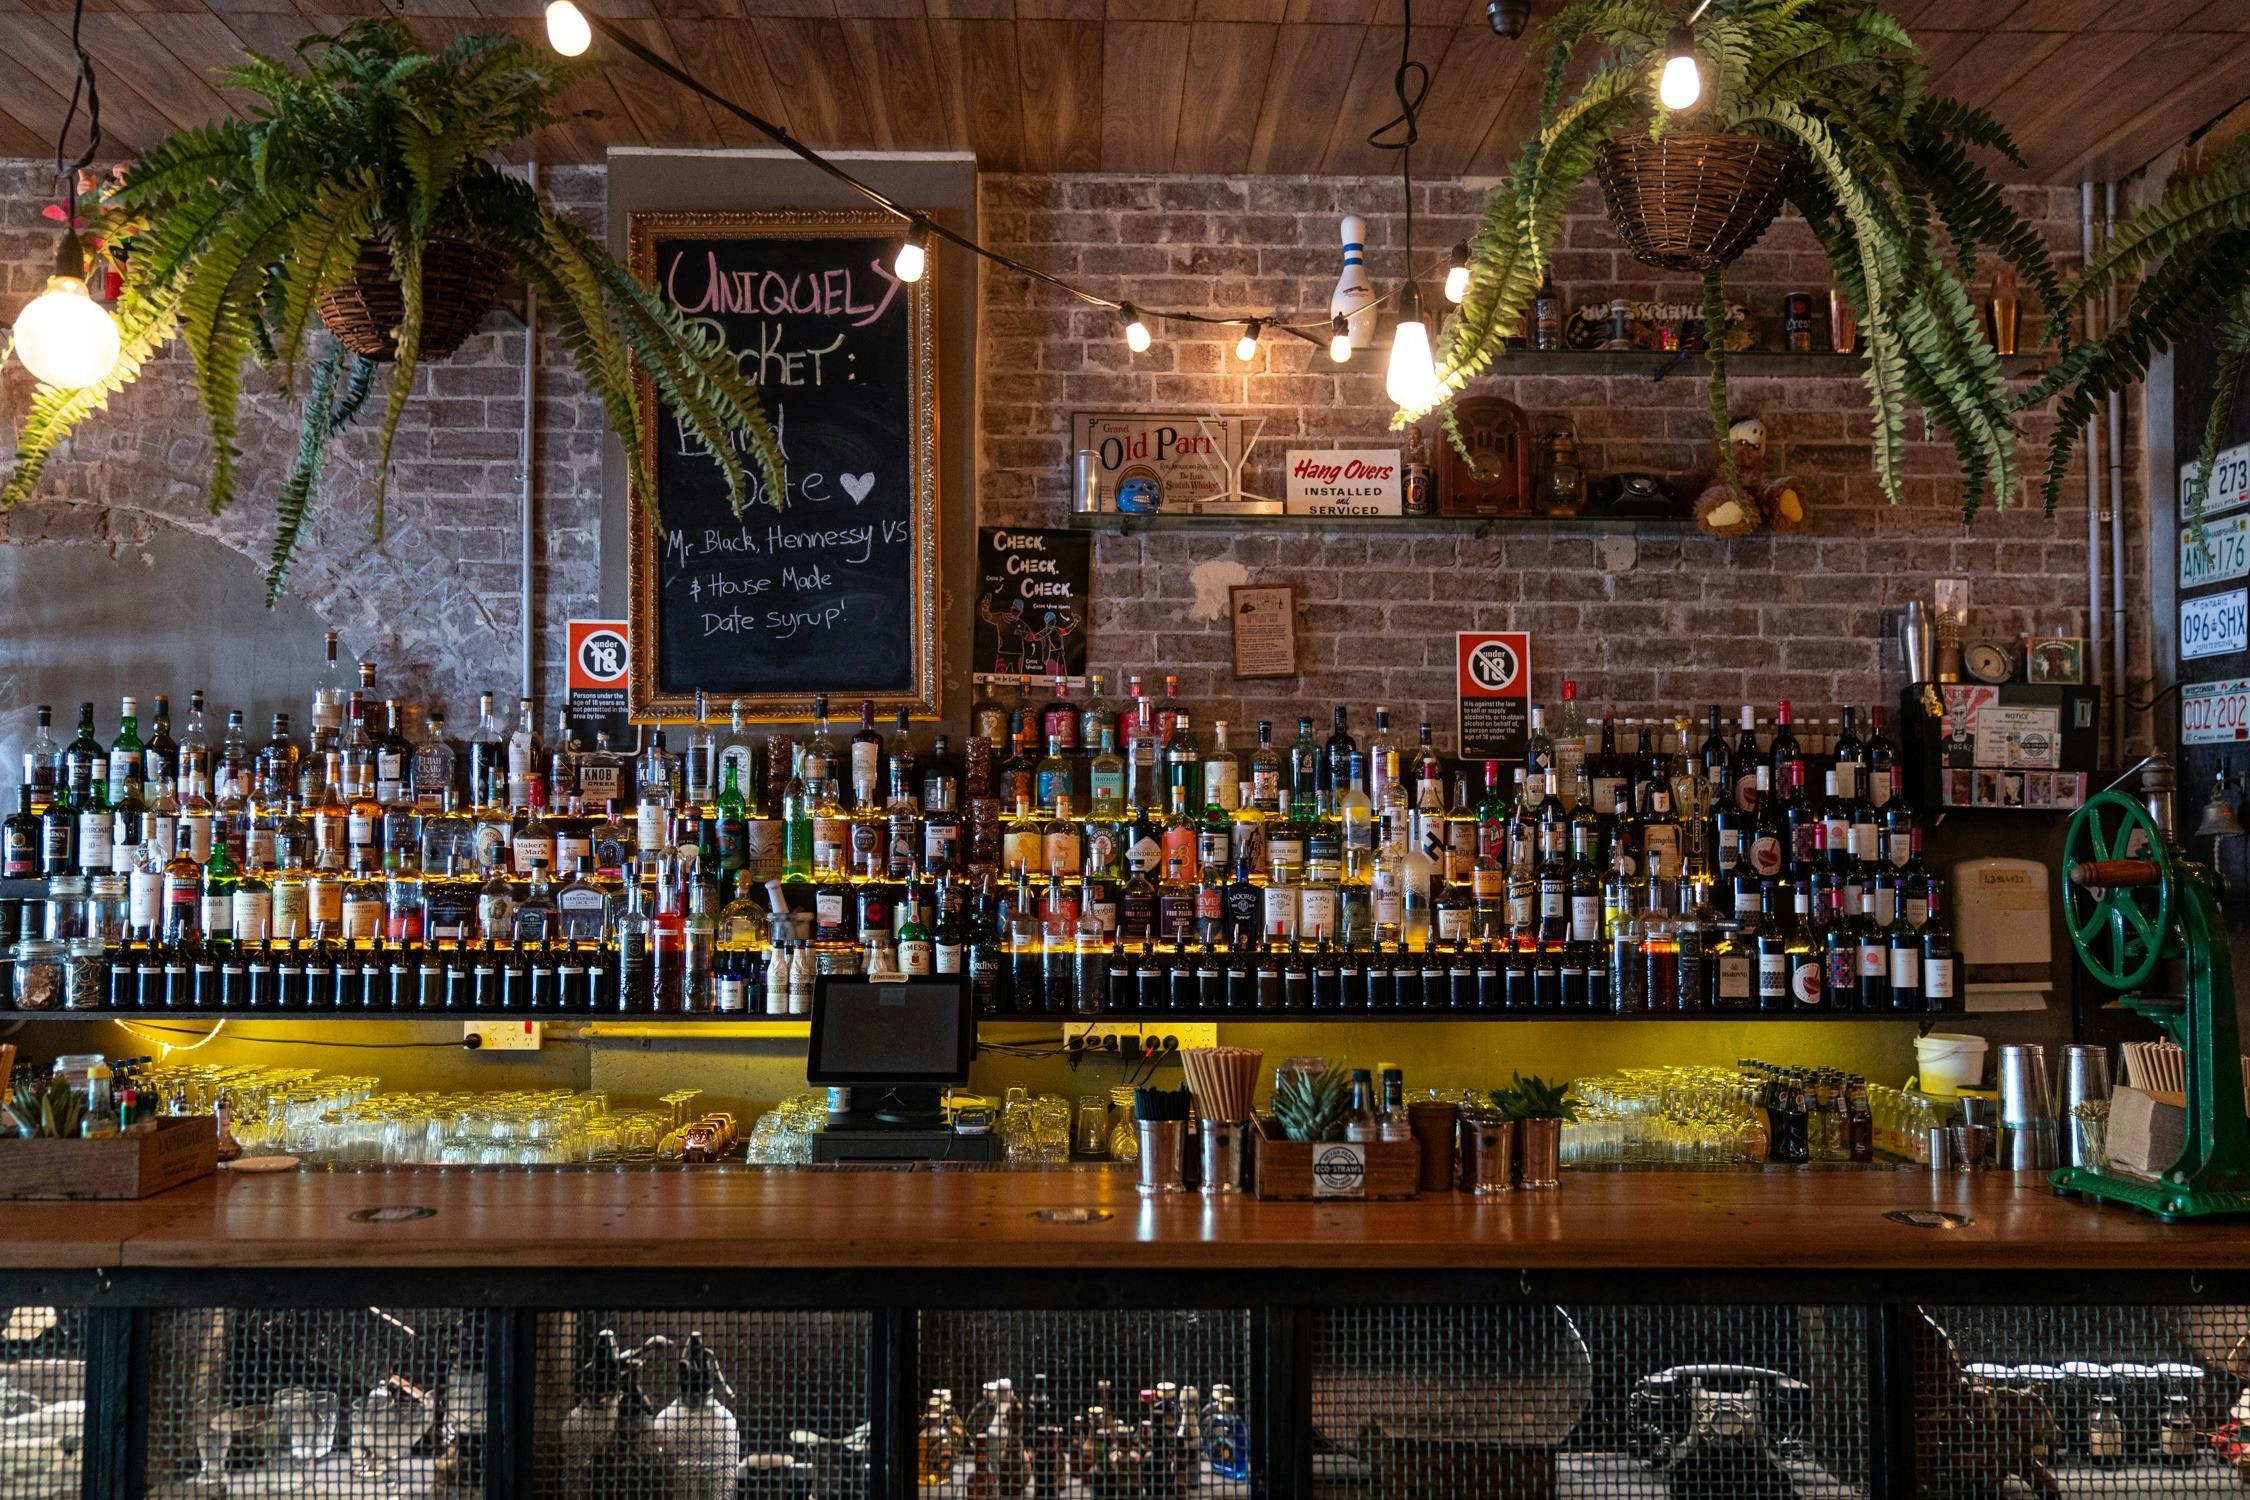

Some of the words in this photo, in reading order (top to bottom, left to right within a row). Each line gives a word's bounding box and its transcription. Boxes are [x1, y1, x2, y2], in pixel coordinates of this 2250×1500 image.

[668, 251, 901, 327] UNIQUELY
[1103, 423, 1130, 434] Grand
[1101, 432, 1149, 471] Old
[1155, 427, 1217, 462] Parr
[1294, 459, 1342, 485] Hang
[1344, 459, 1394, 480] Overs
[2219, 460, 2247, 497] 273
[1305, 488, 1382, 496] INSTALLED
[1336, 496, 1351, 505] and
[1309, 506, 1379, 515] SERVICED
[667, 529, 694, 568] Mr
[699, 527, 760, 554] Black,
[766, 525, 873, 563] Hennessy
[882, 519, 908, 544] VS
[993, 531, 1046, 551] CHECK.
[1006, 554, 1060, 575] CHECK.
[2218, 536, 2245, 571] 176
[708, 573, 771, 597] House
[782, 564, 832, 592] Made
[1020, 577, 1074, 598] CHECK.
[701, 605, 754, 637] Date
[2184, 613, 2210, 645] 096
[2218, 604, 2246, 640] SHX
[594, 640, 619, 648] under
[590, 648, 618, 672] 18
[1480, 658, 1505, 681] 18
[2184, 699, 2212, 731] CDZ
[2217, 696, 2247, 729] 202
[418, 756, 441, 765] ELIJAH
[418, 765, 441, 773] CRAIG
[585, 769, 612, 780] KNOB
